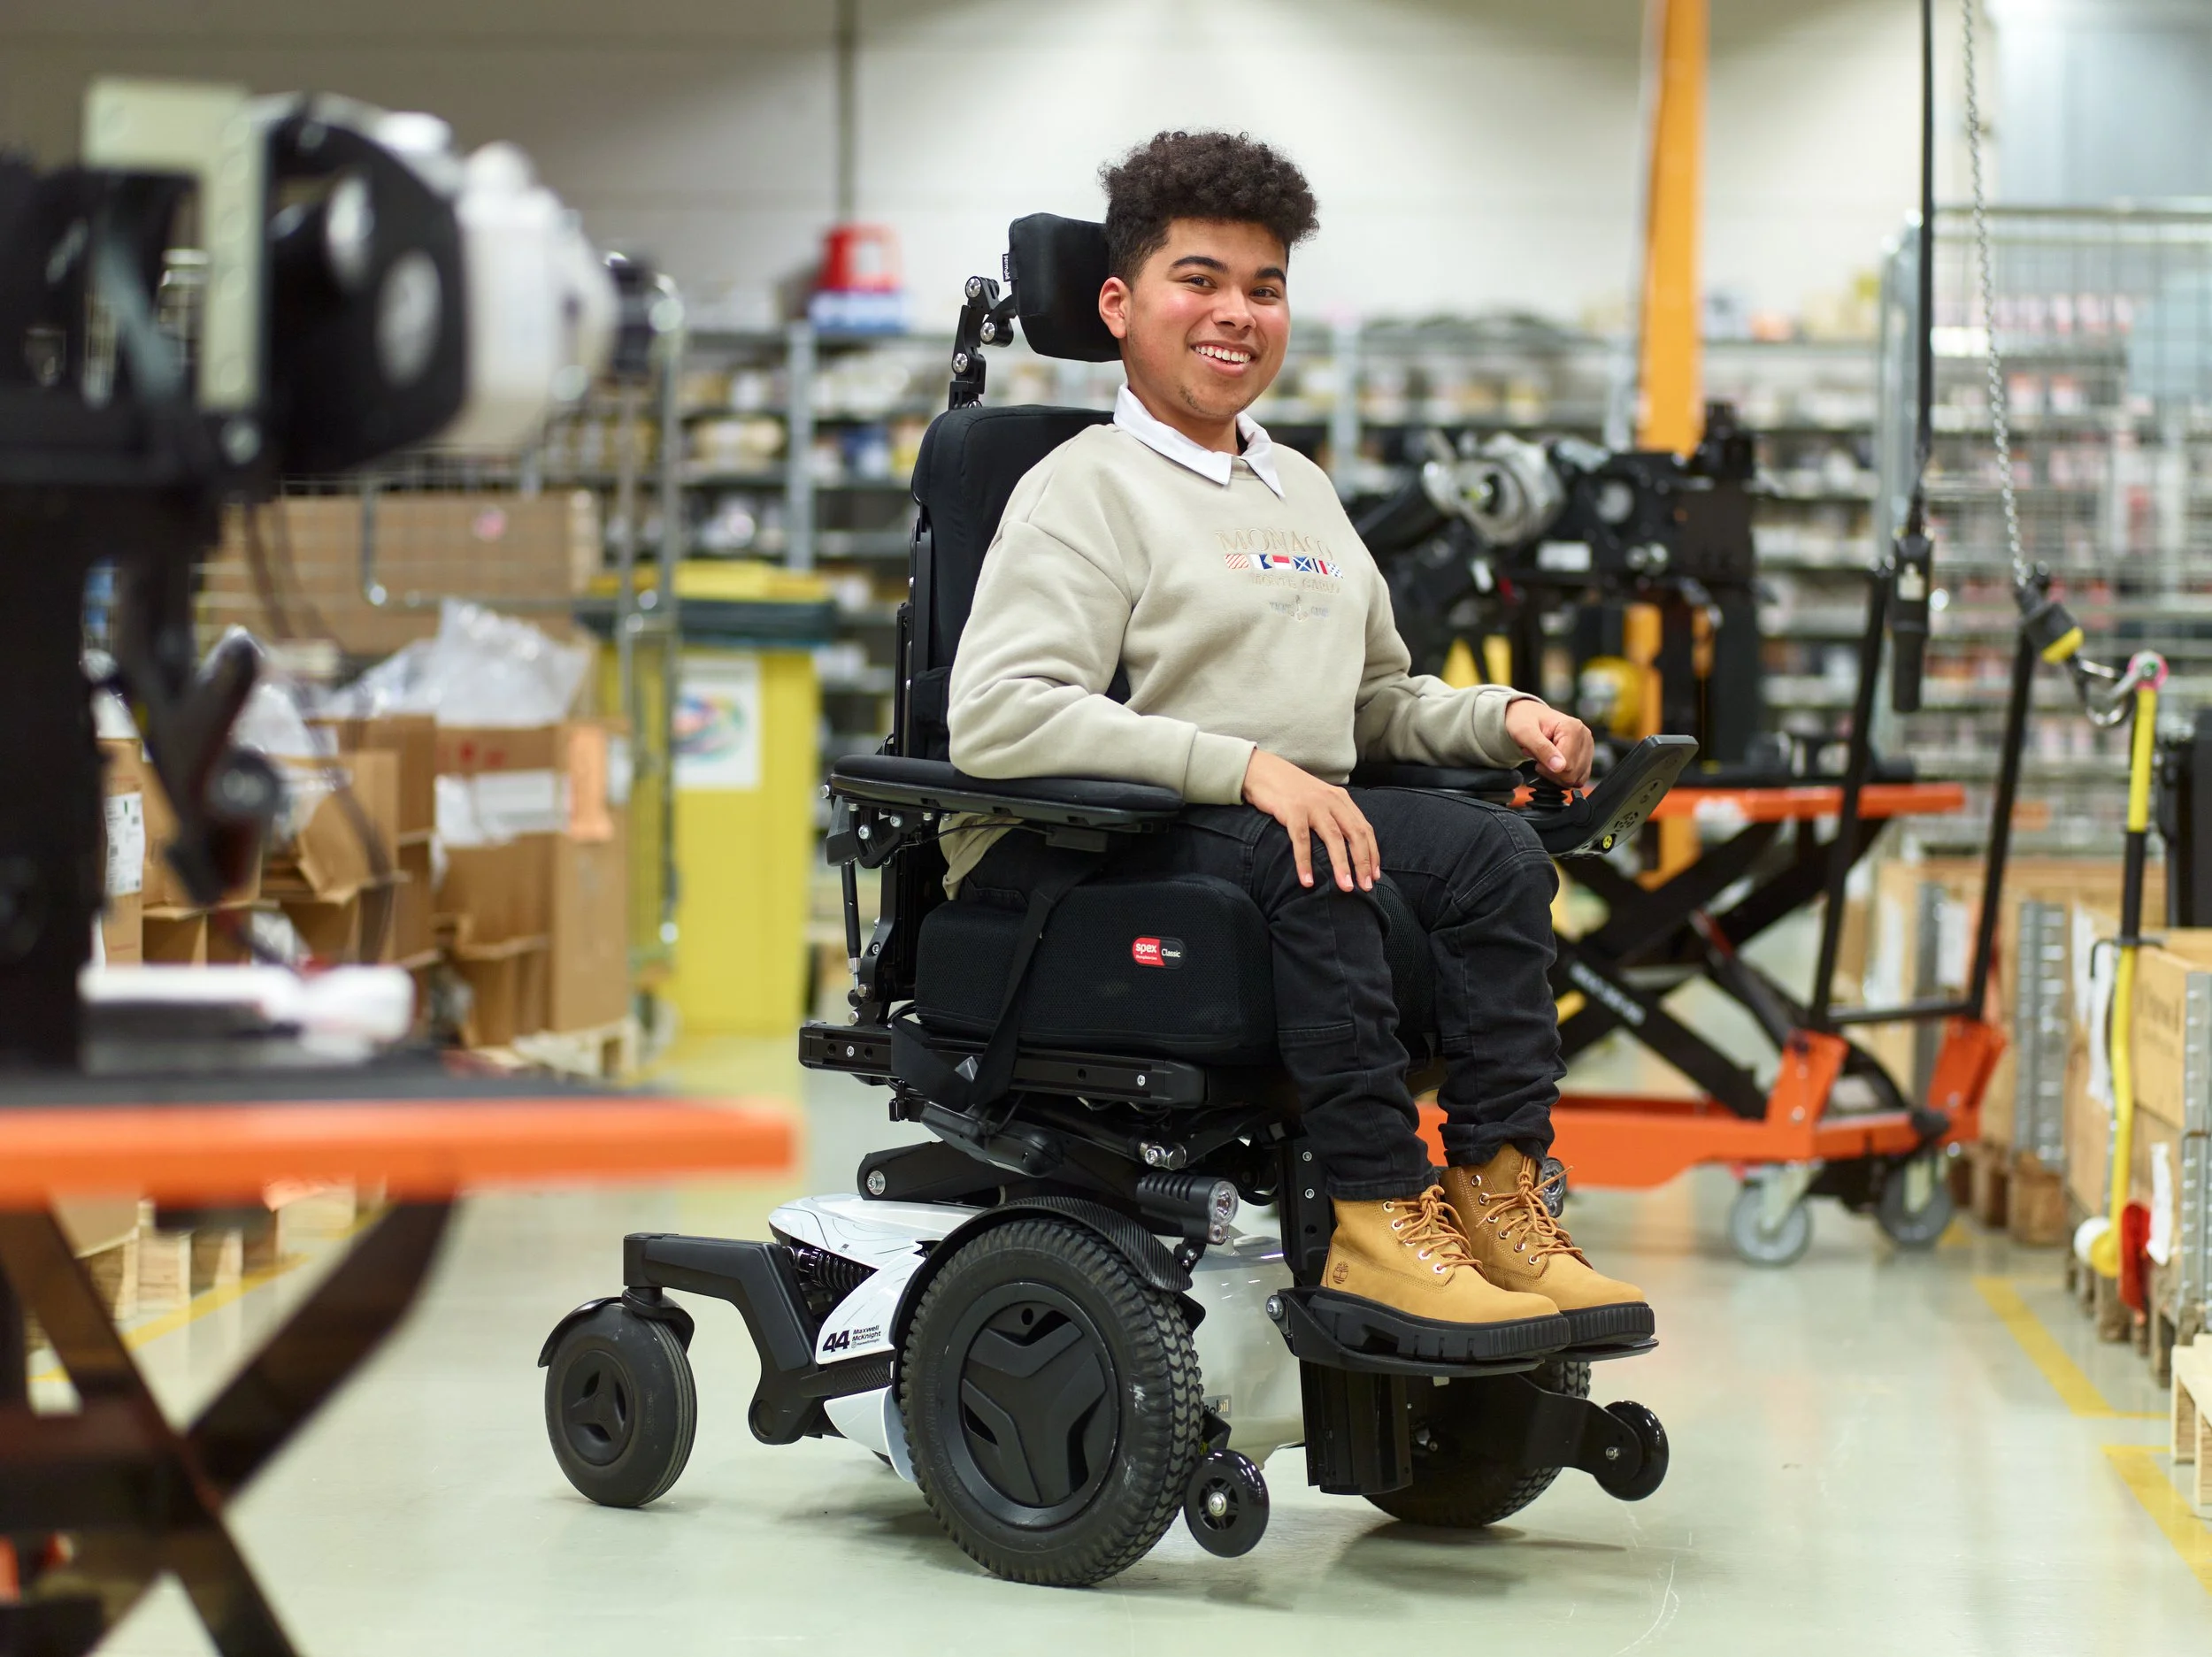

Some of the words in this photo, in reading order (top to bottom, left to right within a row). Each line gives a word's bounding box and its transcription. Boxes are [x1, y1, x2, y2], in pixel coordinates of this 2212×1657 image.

[1135, 943, 1157, 955] spex
[1161, 948, 1181, 957] Classic
[852, 1331, 881, 1341] McKnight
[853, 1325, 879, 1335] Maxwell
[822, 1330, 850, 1353] 44
